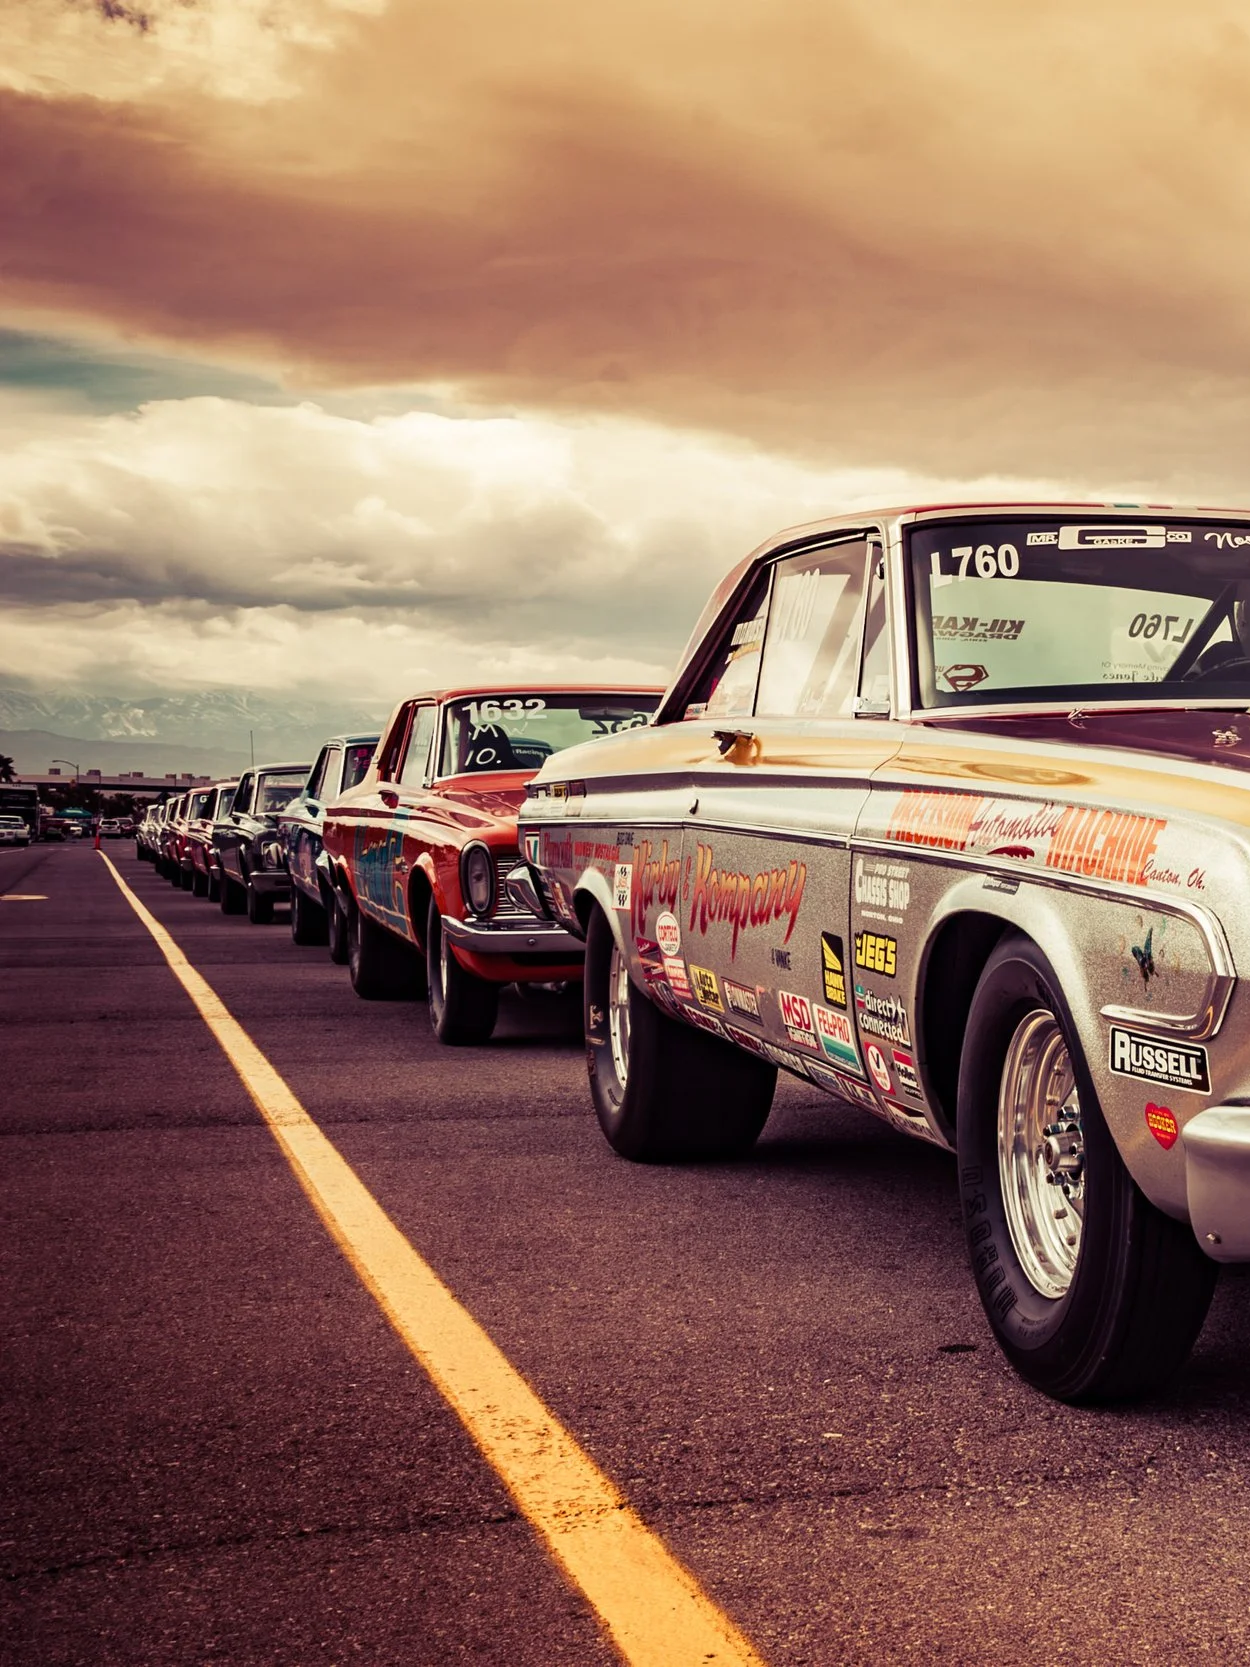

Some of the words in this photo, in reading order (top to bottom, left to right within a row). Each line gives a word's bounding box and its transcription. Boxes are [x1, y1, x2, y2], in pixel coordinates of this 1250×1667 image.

[1093, 538, 1138, 546] GASKE
[930, 543, 1020, 588] L760
[462, 698, 547, 723] 1632
[1046, 805, 1167, 886] MACHINE
[631, 839, 681, 940] Kirby
[689, 842, 807, 963] Kompany
[888, 878, 910, 911] SHOP
[855, 933, 897, 975] JEG'S
[781, 993, 811, 1030] MSD
[817, 1008, 850, 1043] FEL-PRO
[859, 1012, 904, 1042] connected
[1114, 1031, 1203, 1080] RUSSELL
[1145, 1070, 1169, 1080] TRANSFER
[1169, 1075, 1193, 1085] SYSTEMS
